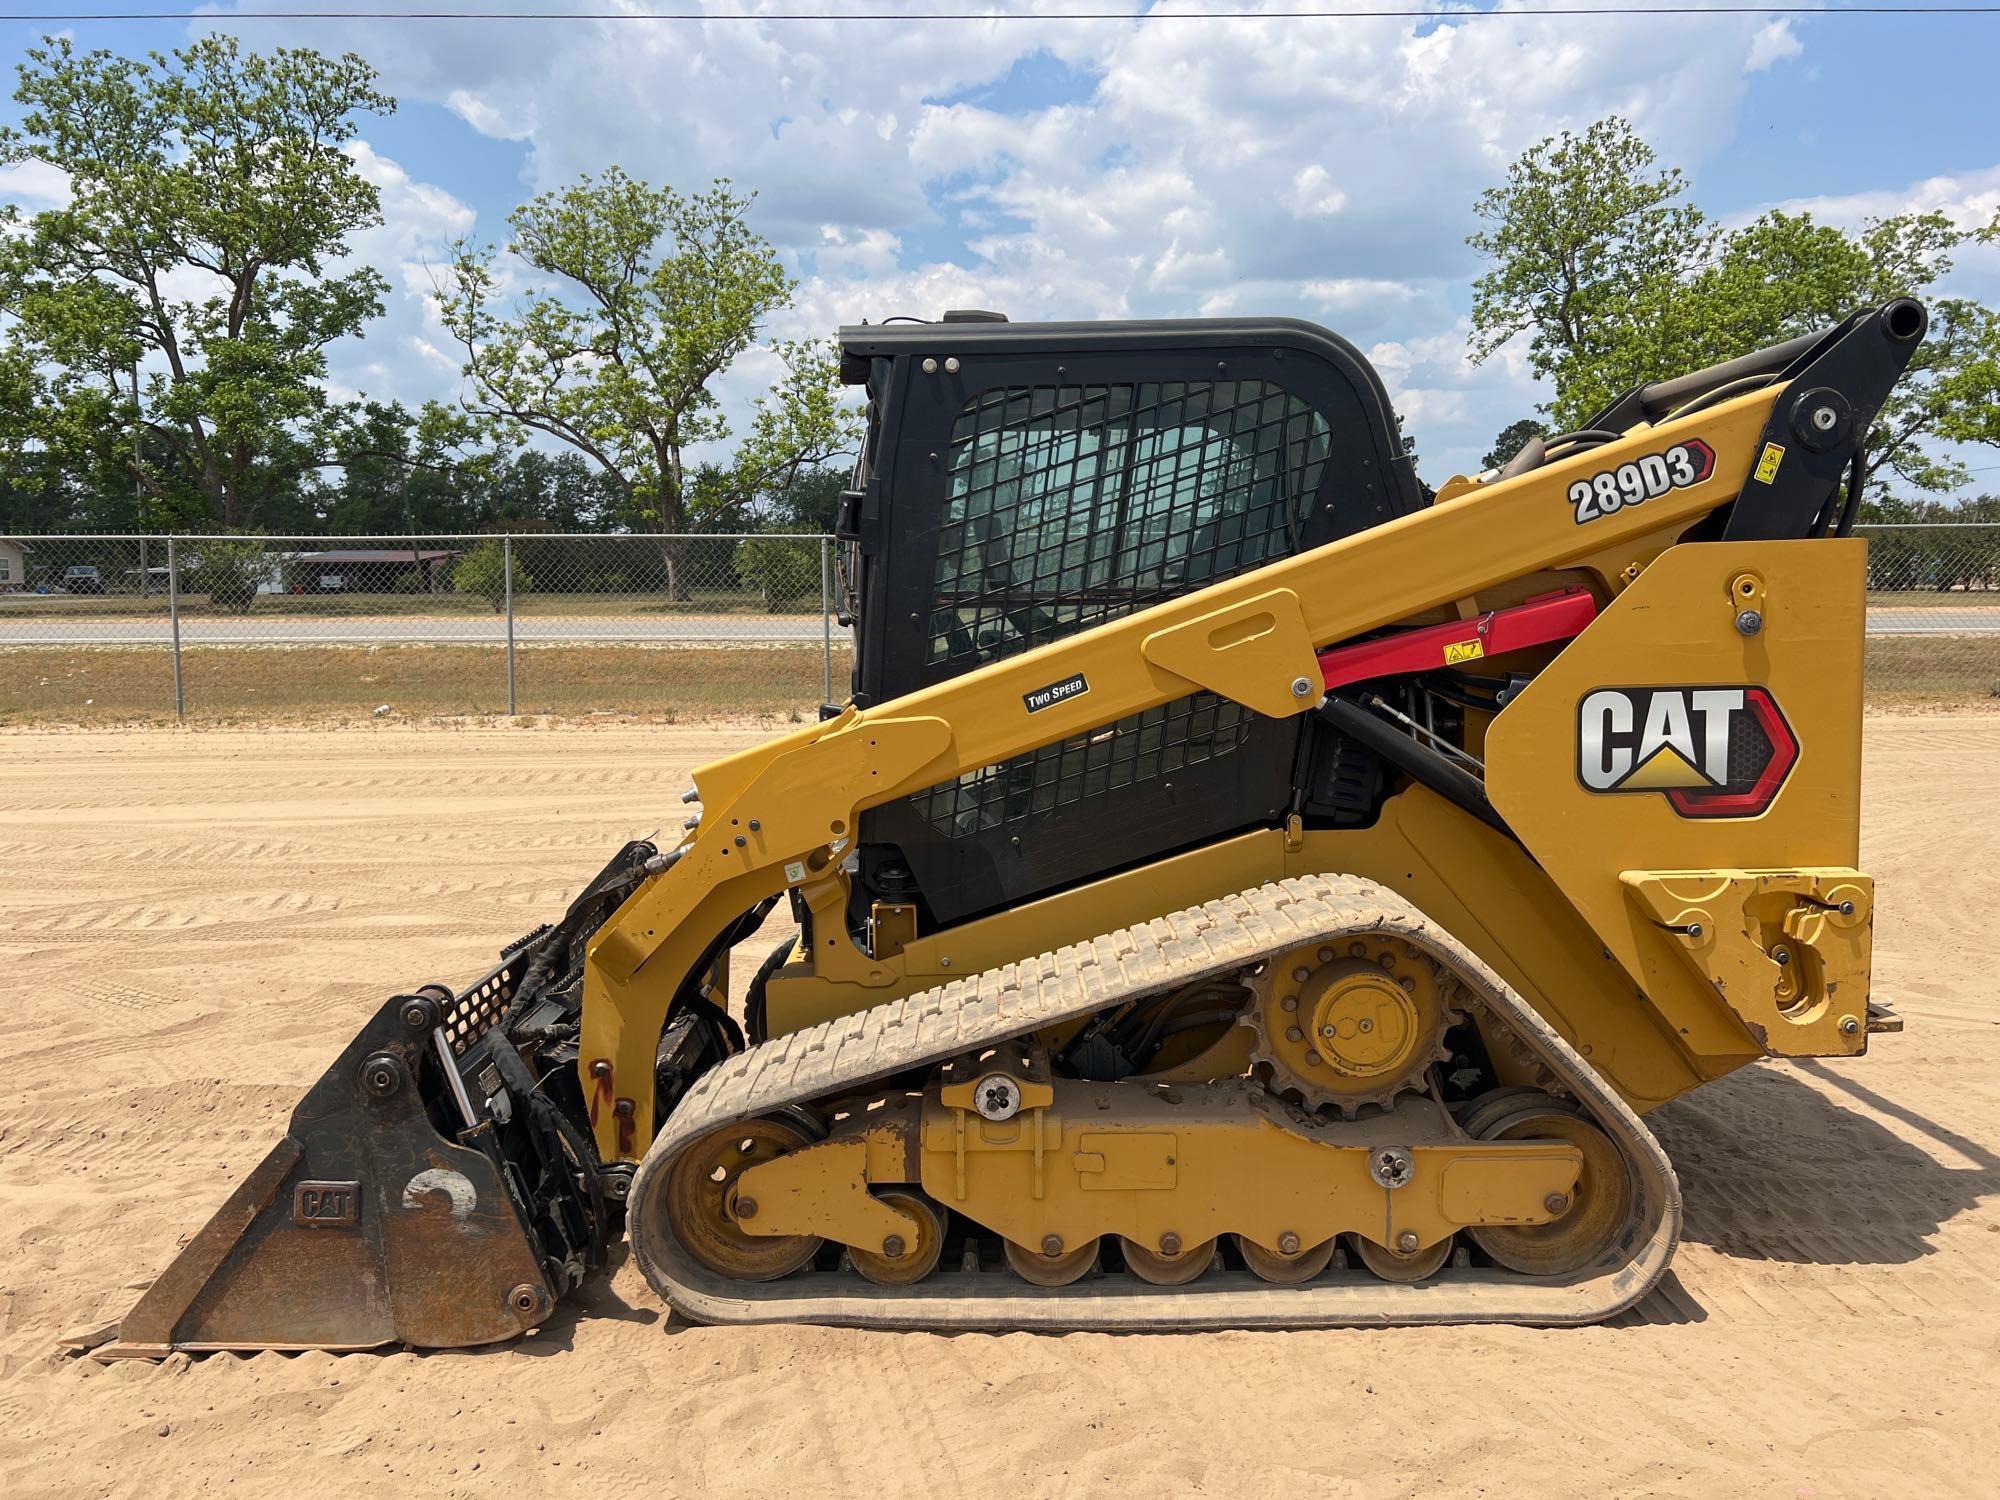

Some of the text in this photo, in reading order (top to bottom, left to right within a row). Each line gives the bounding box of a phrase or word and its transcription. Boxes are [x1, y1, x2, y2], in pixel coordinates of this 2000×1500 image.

[1569, 446, 1695, 522] 289D3
[1581, 689, 1744, 789] CAT
[303, 1190, 351, 1218] CAT
